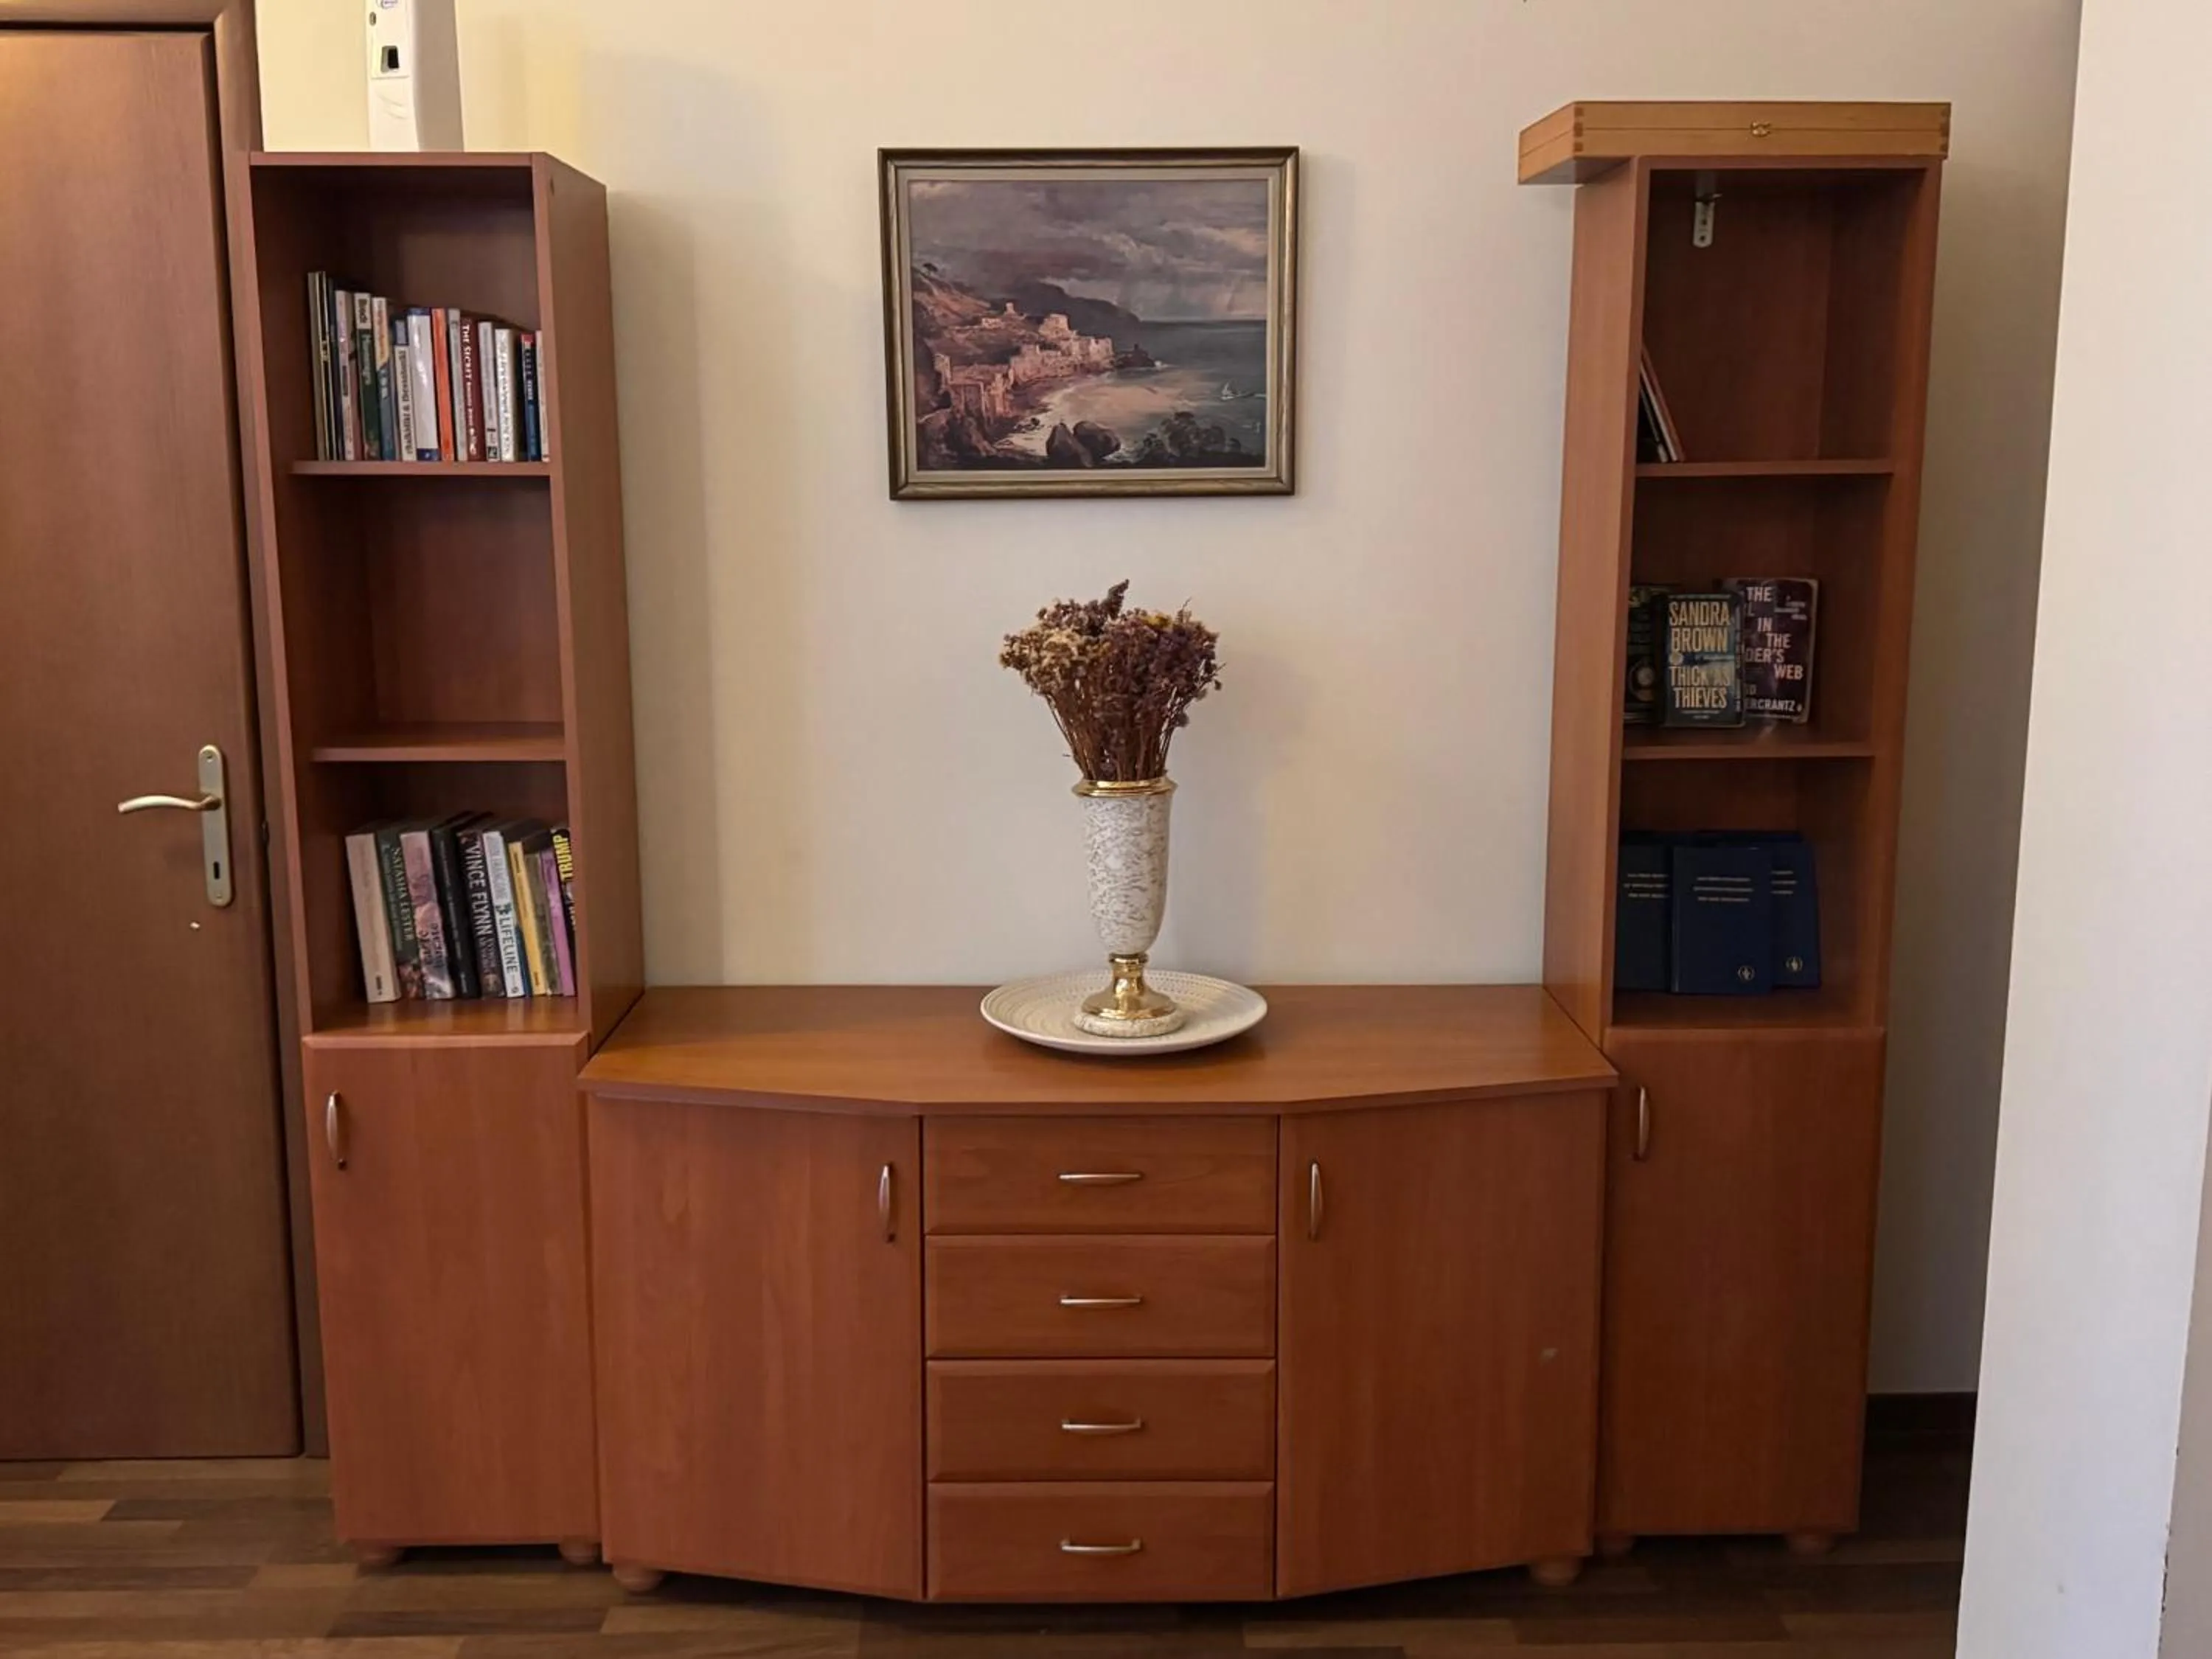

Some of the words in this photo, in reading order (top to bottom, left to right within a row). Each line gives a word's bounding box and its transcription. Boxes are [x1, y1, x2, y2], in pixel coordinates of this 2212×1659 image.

[462, 324, 470, 342] THE
[1746, 586, 1772, 602] THE
[1669, 602, 1731, 626] SANDRA
[1757, 617, 1773, 632] IN
[1671, 627, 1728, 653] BROWN
[1766, 633, 1792, 649] THE
[1745, 648, 1784, 664] DER'S
[1669, 666, 1705, 686] THICK
[1714, 666, 1731, 686] AS
[1773, 664, 1804, 680] WEB
[1674, 688, 1728, 709] THIEVES
[465, 844, 486, 889] VINCE
[553, 834, 573, 882] TRUMP
[471, 892, 493, 939] FLYNN
[498, 917, 518, 973] LIFELINE
